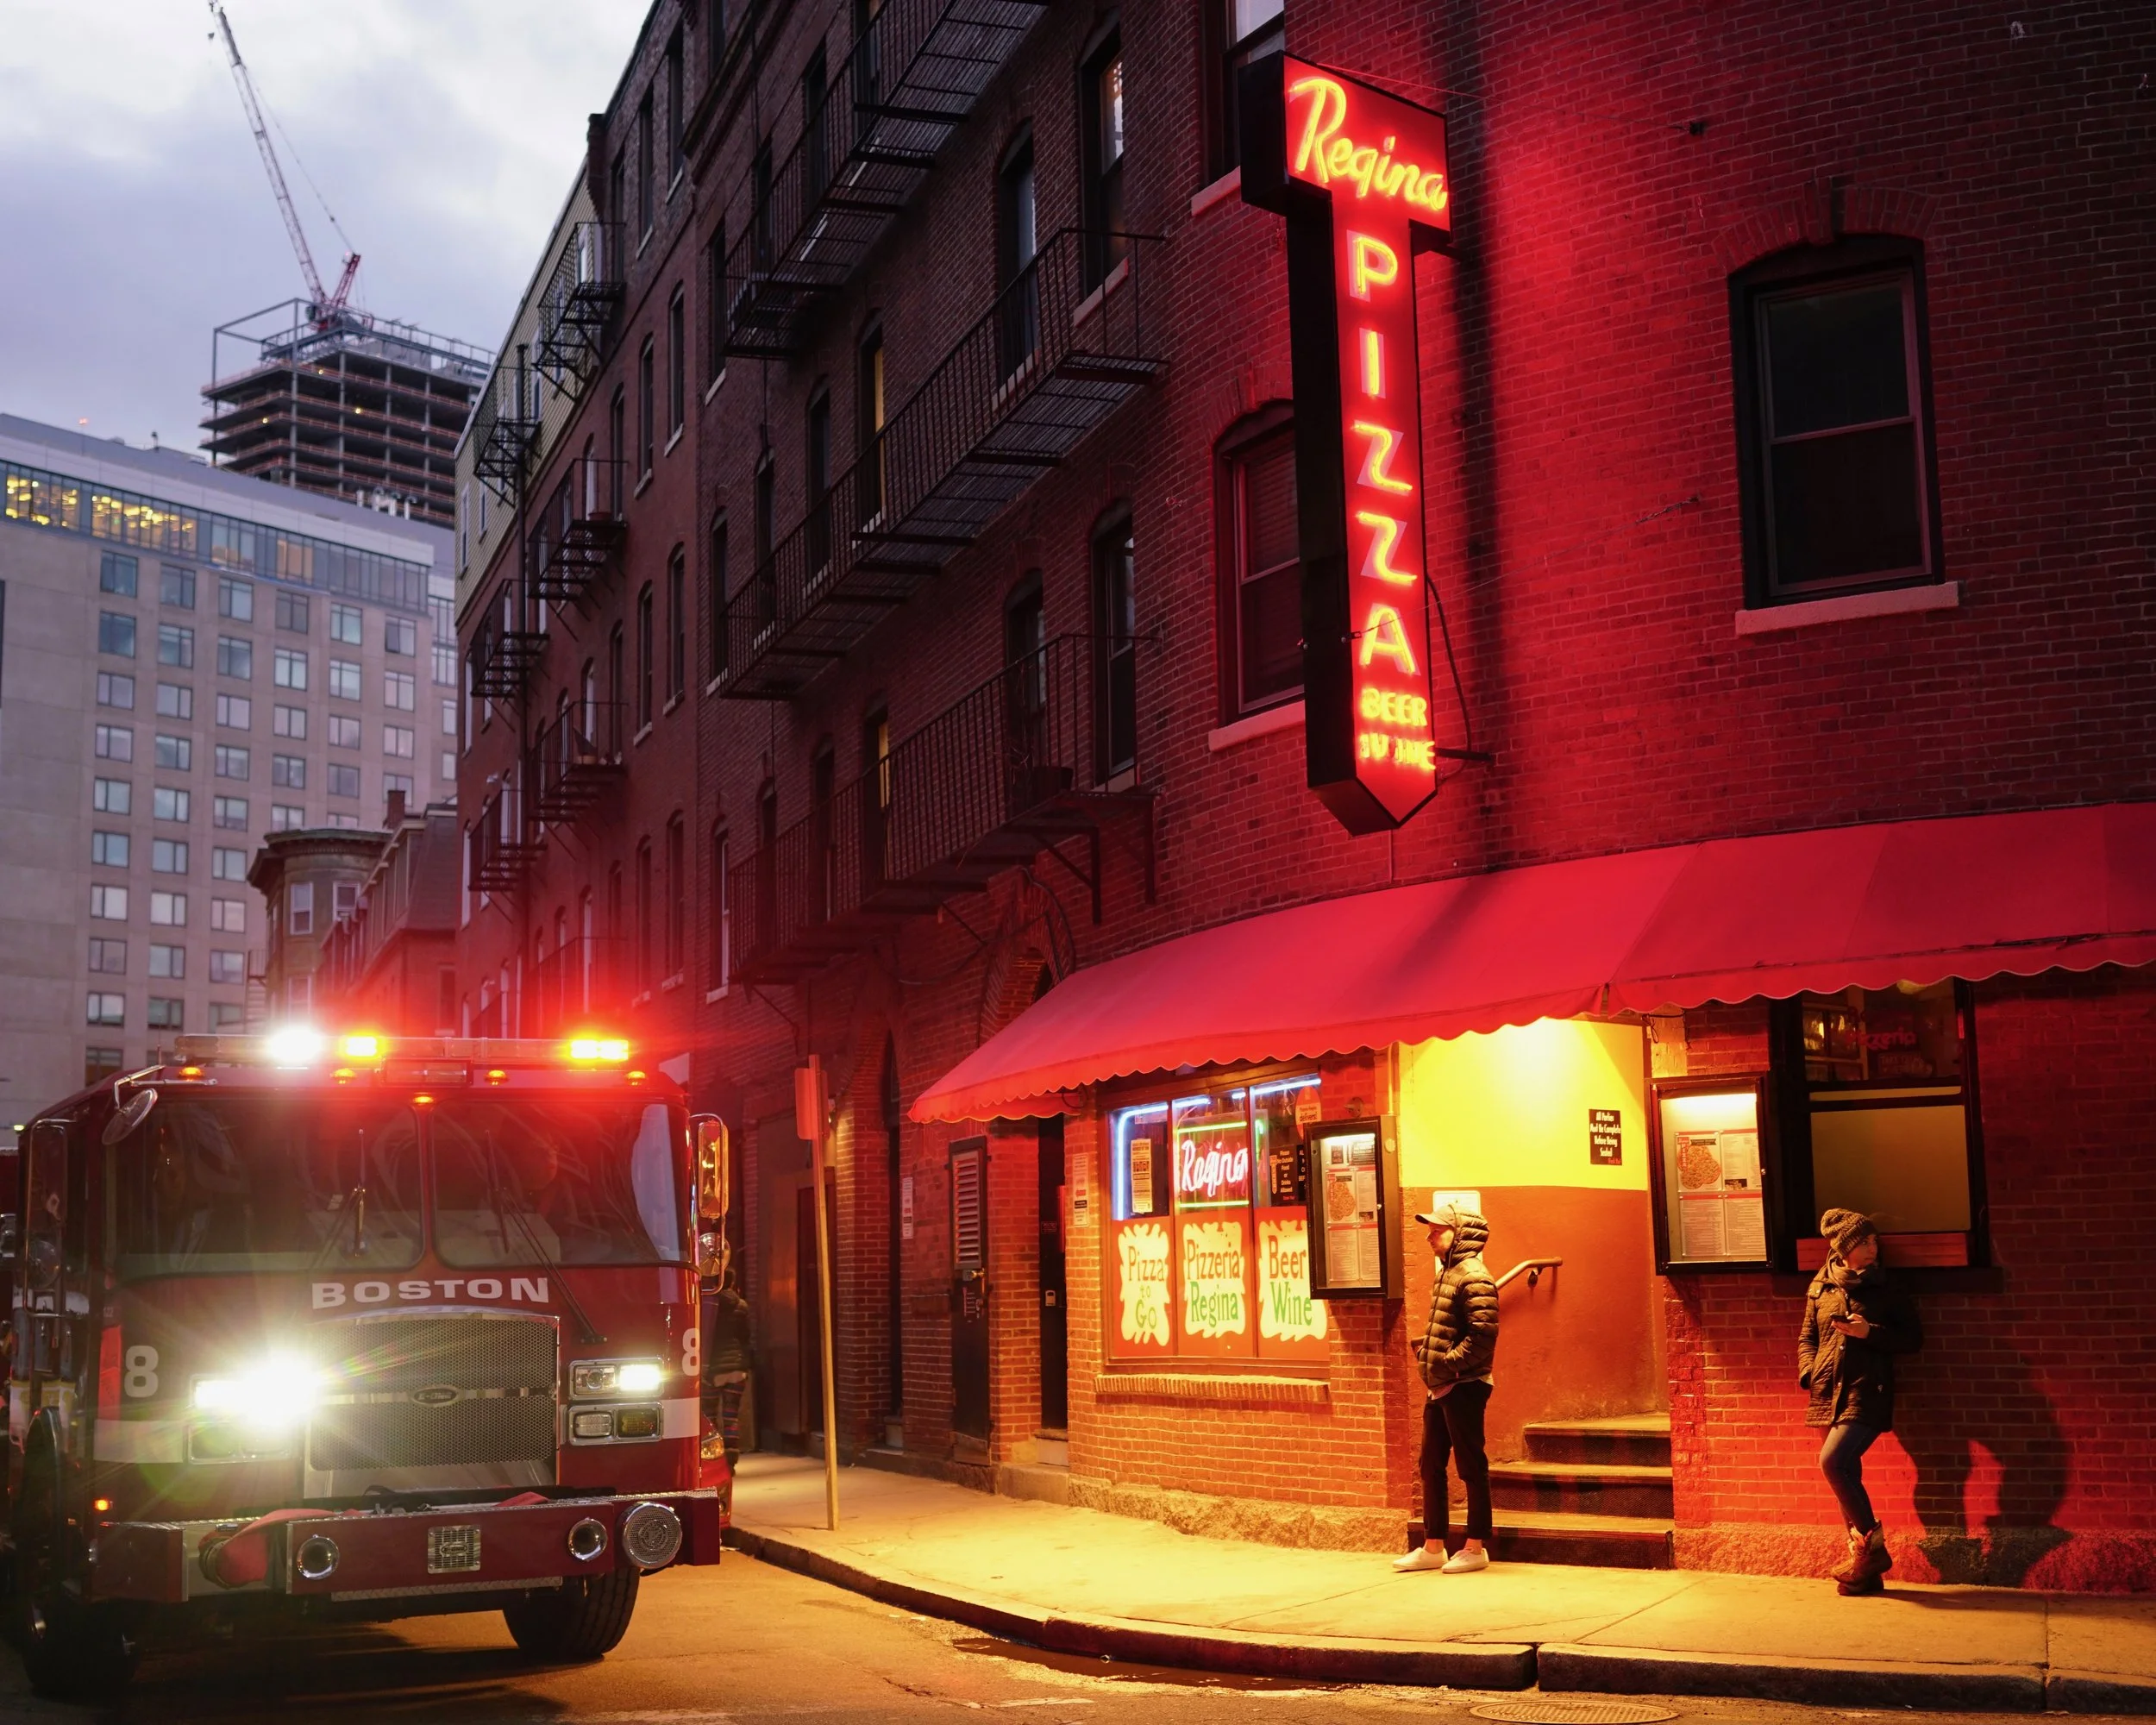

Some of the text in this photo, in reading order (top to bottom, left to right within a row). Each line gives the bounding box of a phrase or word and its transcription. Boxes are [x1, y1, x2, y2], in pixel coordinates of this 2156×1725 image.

[1288, 75, 1448, 211] Regina
[1347, 229, 1423, 676] PIZZA
[1360, 687, 1428, 727] BEER
[1181, 1139, 1248, 1197] Regina
[1128, 1245, 1164, 1282] Pizza
[1187, 1239, 1240, 1280] Pizzeria
[1268, 1235, 1307, 1279] Beer
[311, 1277, 549, 1309] BOSTON
[1140, 1285, 1151, 1298] to
[1190, 1281, 1238, 1328] Regina
[1270, 1282, 1313, 1327] Wine
[1136, 1299, 1156, 1329] Go
[124, 1346, 159, 1398] 8
[682, 1327, 700, 1377] 8
